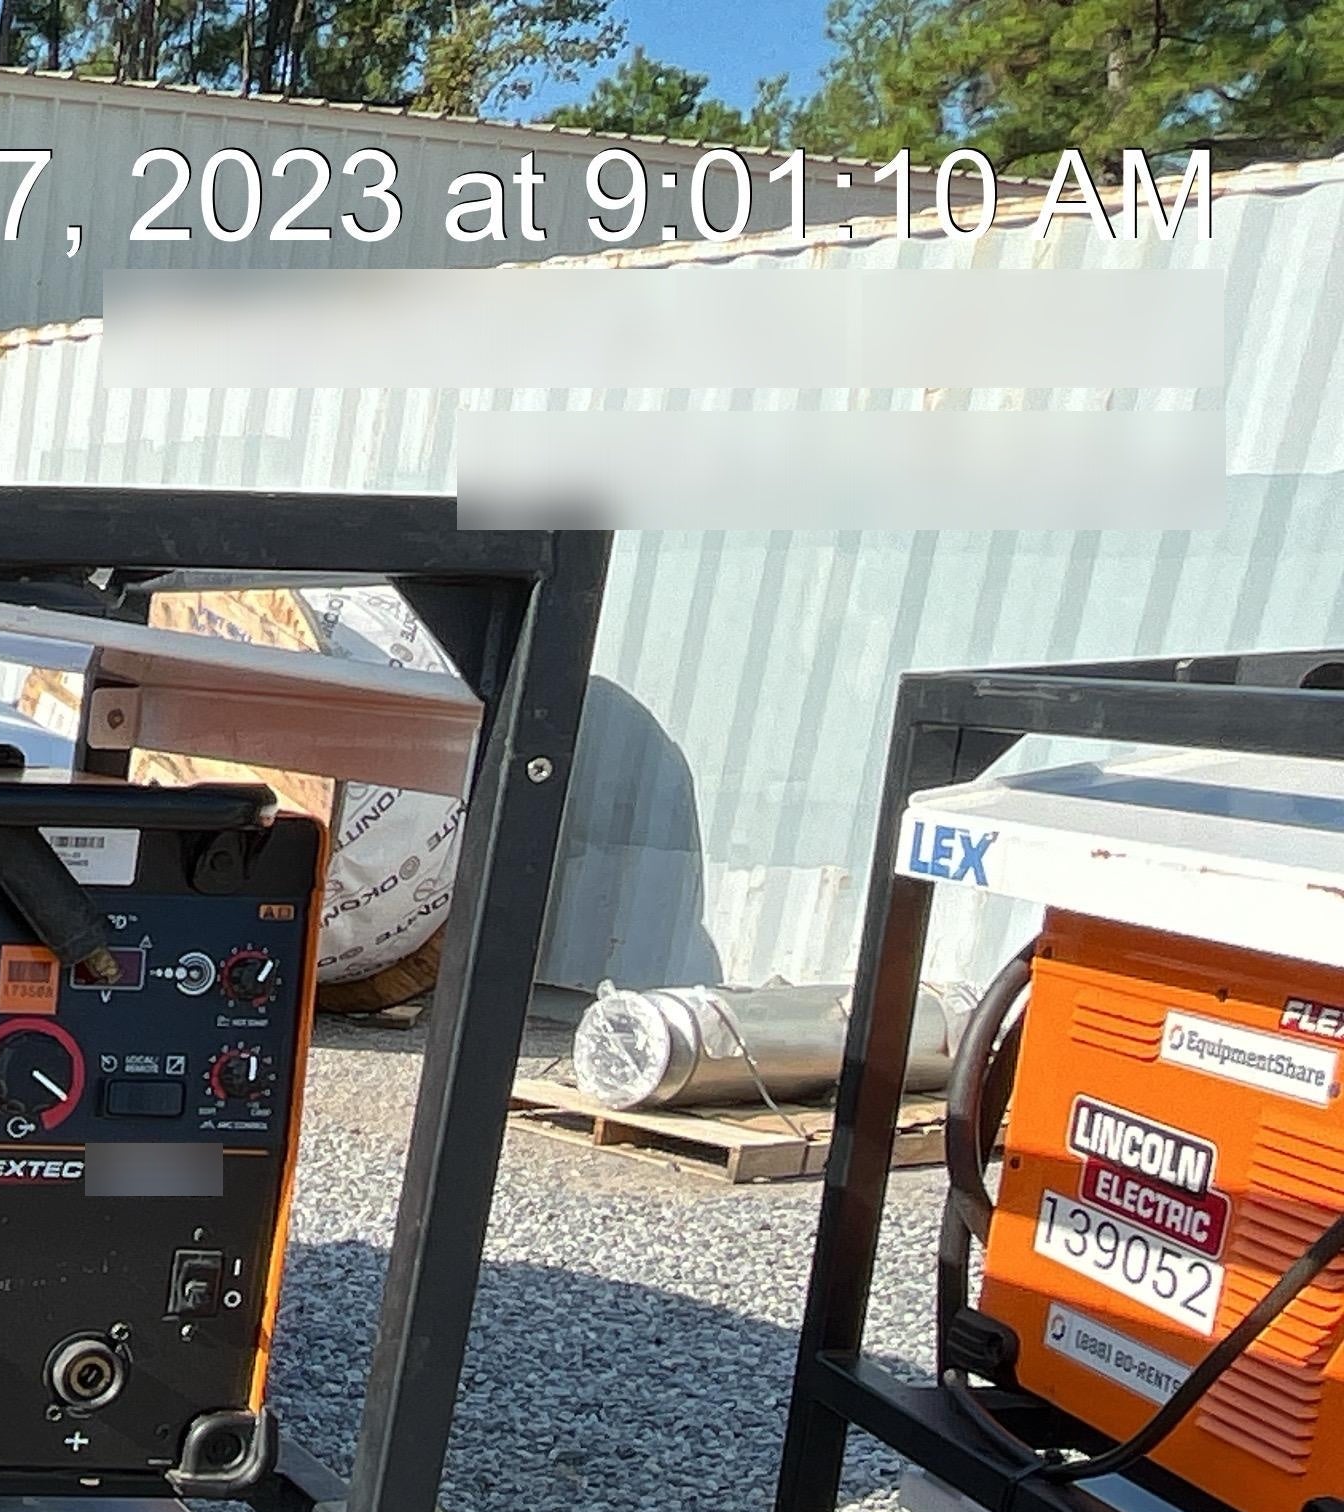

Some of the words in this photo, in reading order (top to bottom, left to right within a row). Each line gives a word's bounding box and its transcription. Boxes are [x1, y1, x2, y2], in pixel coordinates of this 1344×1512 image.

[909, 820, 999, 886] LEX
[100, 991, 112, 1003] V
[1186, 1029, 1326, 1087] EquipmentShare
[1075, 1104, 1209, 1194] LINCOLN
[1096, 1170, 1212, 1243] ELECTRIC
[1042, 1196, 1214, 1318] 139052
